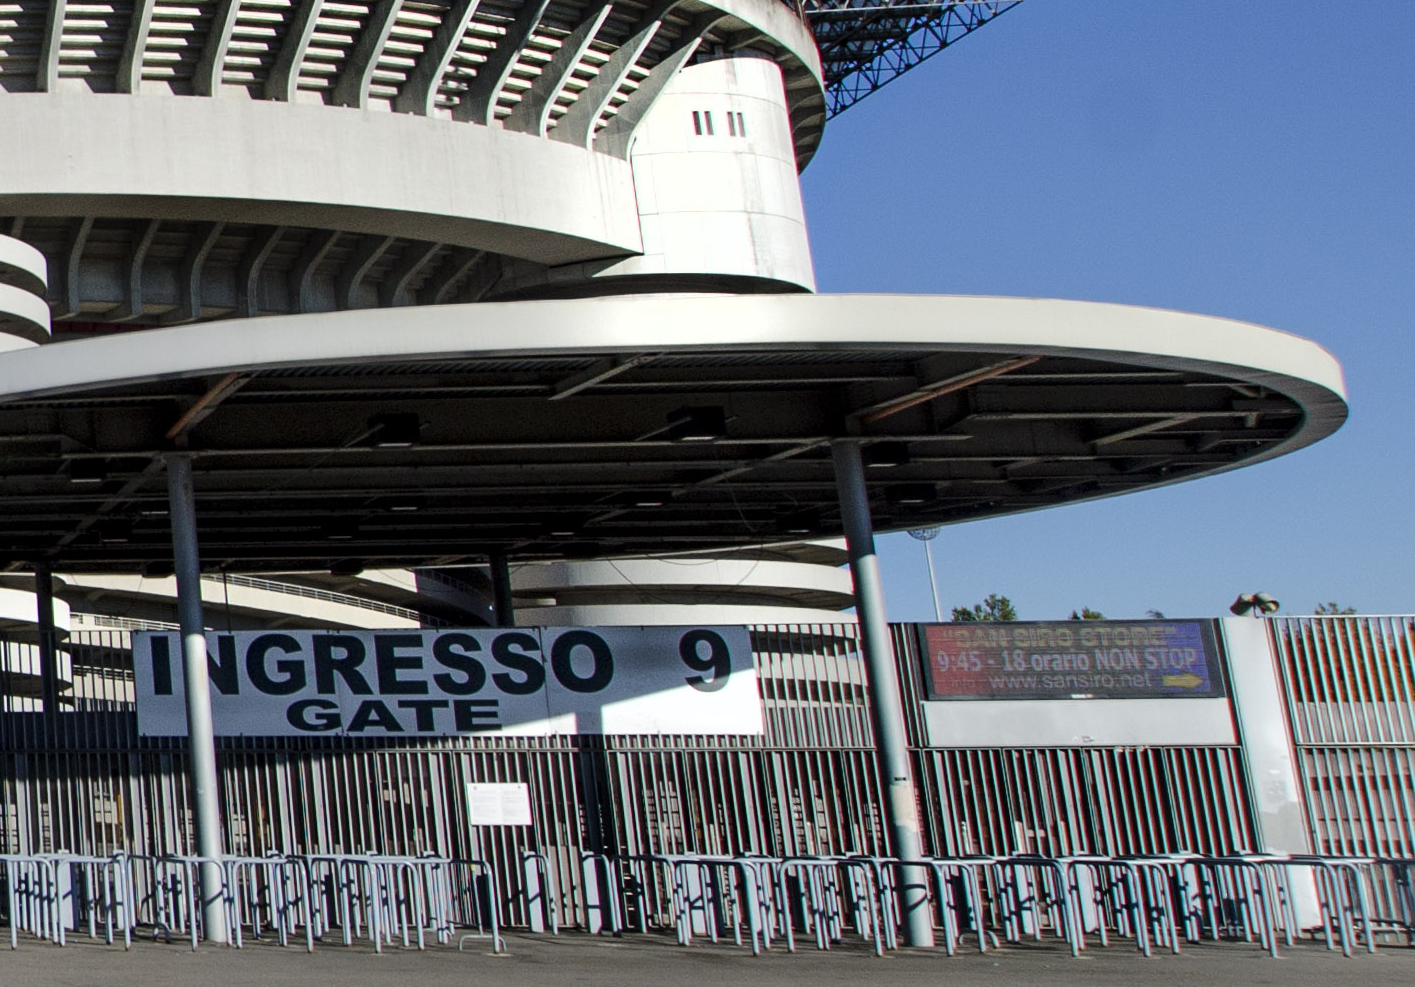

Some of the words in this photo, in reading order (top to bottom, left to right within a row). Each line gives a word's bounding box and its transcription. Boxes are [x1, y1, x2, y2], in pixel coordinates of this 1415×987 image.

[150, 629, 615, 696] INGRESSO
[678, 629, 732, 693] 9
[936, 650, 982, 672] 9:45
[1001, 649, 1026, 671] 18
[1031, 648, 1090, 671] orario
[1095, 648, 1139, 671] NON
[1144, 647, 1197, 670] STOP
[990, 670, 1151, 689] www.sansiro.net
[286, 699, 503, 732] GATE
